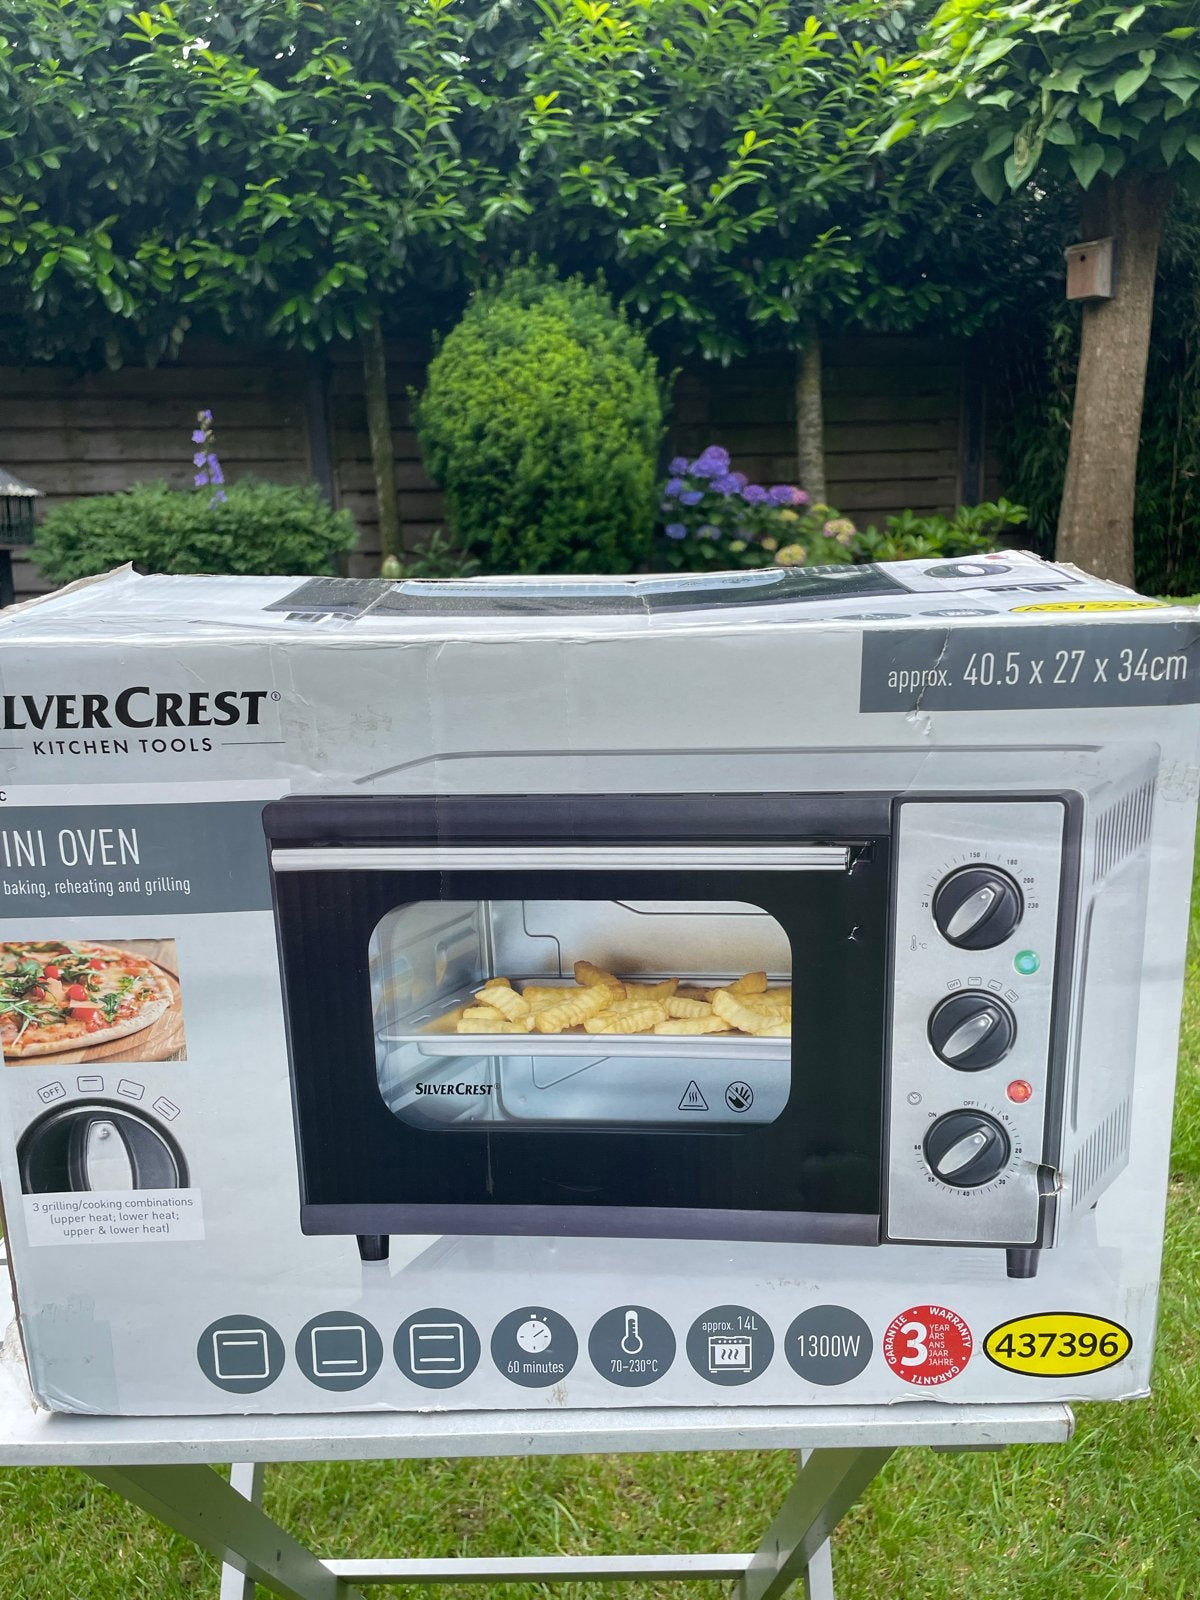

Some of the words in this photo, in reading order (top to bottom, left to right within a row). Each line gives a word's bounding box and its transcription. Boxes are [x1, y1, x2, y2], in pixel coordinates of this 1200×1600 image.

[888, 666, 952, 693] approx.
[963, 652, 1021, 686] 40.5
[1029, 660, 1044, 685] x
[1053, 650, 1086, 684] 27
[1094, 658, 1109, 683] x
[1118, 648, 1188, 682] 34cm
[0, 686, 268, 730] LVERCREST
[33, 739, 129, 755] KITCHEN
[139, 738, 213, 753] TOOLS
[58, 828, 140, 867] OVEN
[3, 879, 51, 898] baking,
[55, 878, 114, 897] reheating
[118, 877, 141, 893] and
[145, 876, 191, 896] grilling
[42, 1086, 61, 1099] OFF
[32, 1202, 40, 1212] 3
[42, 1199, 122, 1213] grilling/cooking
[125, 1197, 193, 1208] combinations
[50, 1213, 86, 1225] (upper
[89, 1212, 116, 1222] heat;
[119, 1212, 149, 1222] lower
[152, 1210, 180, 1221] heat;
[63, 1227, 95, 1238] upper
[98, 1225, 106, 1235] &
[109, 1224, 139, 1235] lower
[142, 1222, 170, 1234] heat)
[702, 1320, 734, 1333] approx.
[737, 1315, 759, 1331] 14L
[929, 1306, 972, 1348] WARRANTY
[929, 1323, 950, 1332] YEAR
[797, 1334, 861, 1358] 1300W
[884, 1315, 908, 1365] GARANTIE
[900, 1321, 928, 1367] 3
[928, 1341, 945, 1349] ANS
[994, 1332, 1120, 1359] 437396
[928, 1349, 949, 1358] JAAR
[928, 1358, 954, 1366] JAHRE
[507, 1360, 521, 1374] 60
[522, 1360, 565, 1374] minutes
[911, 1365, 960, 1385] GARANTI
